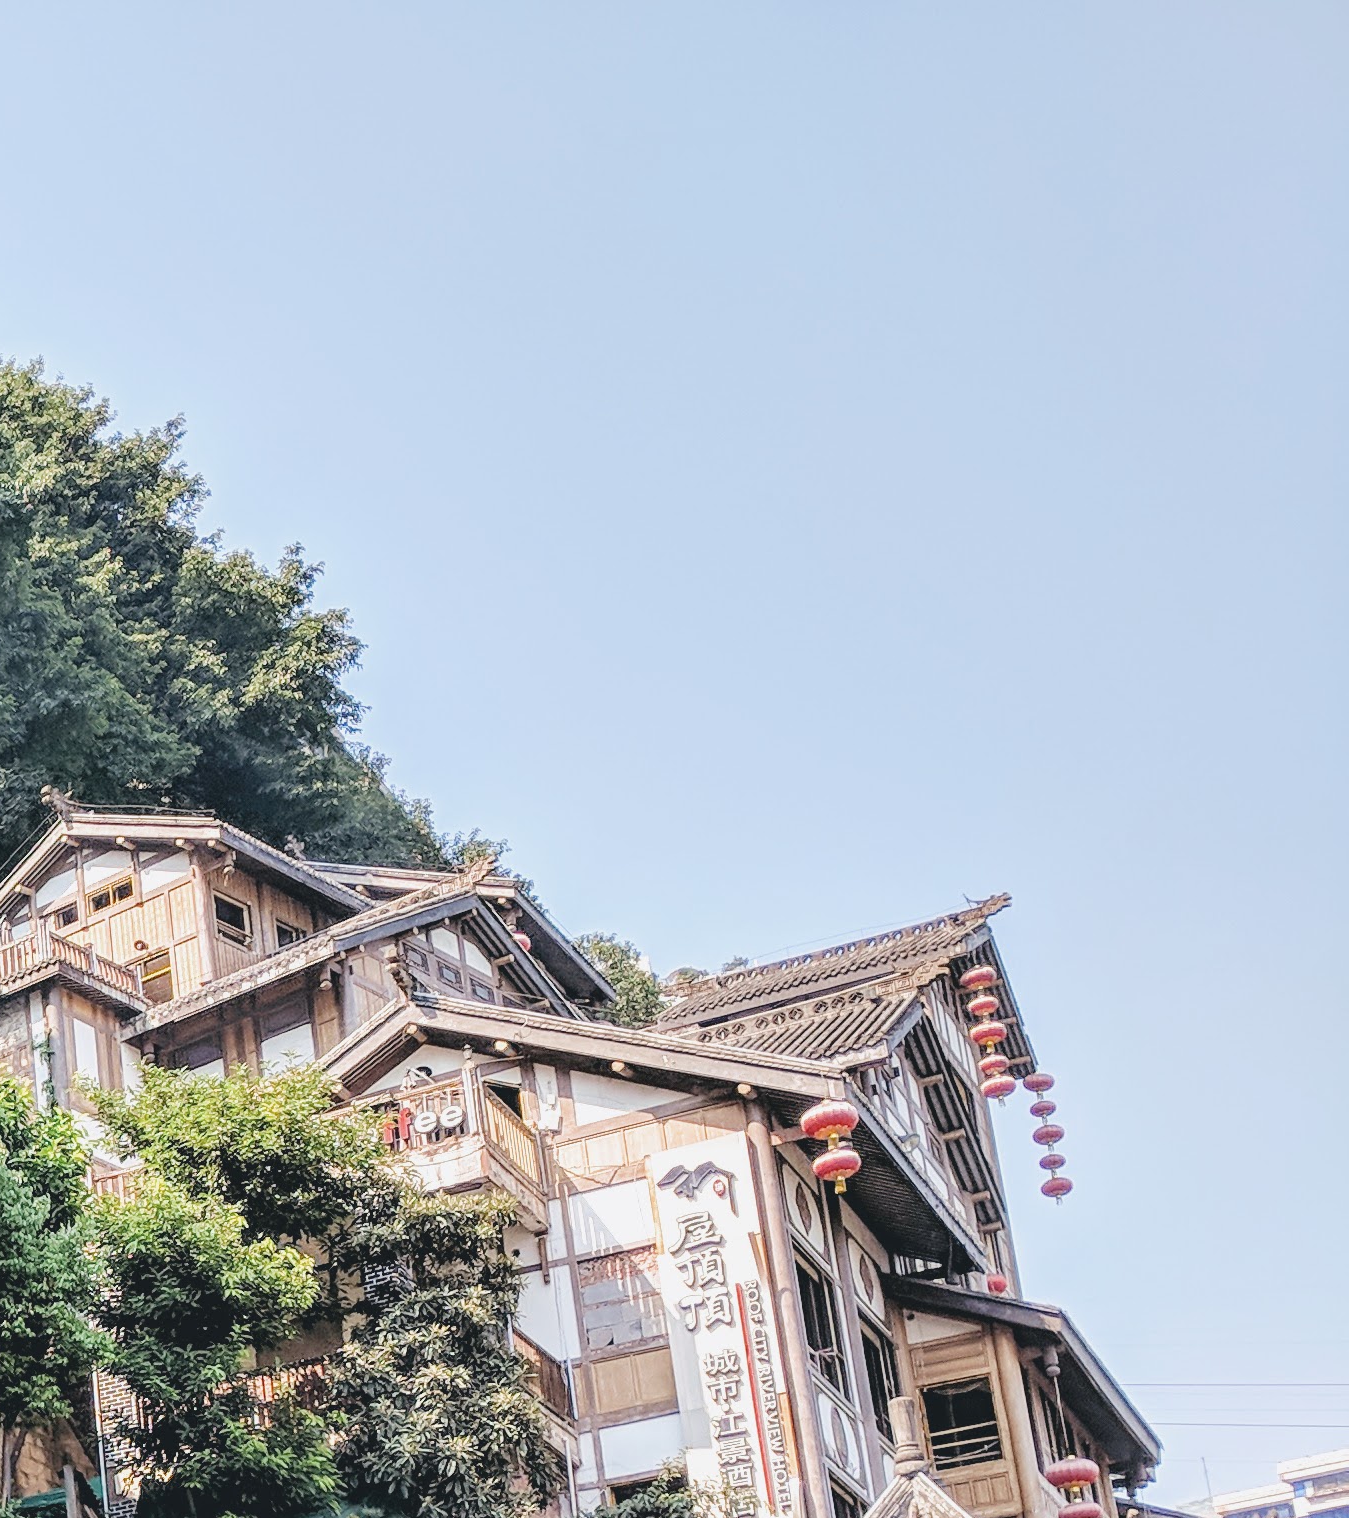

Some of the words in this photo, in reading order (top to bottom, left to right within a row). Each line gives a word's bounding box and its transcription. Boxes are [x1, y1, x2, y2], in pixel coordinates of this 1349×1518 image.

[744, 1279, 764, 1324] ROOF
[752, 1327, 771, 1365] CITY
[772, 1456, 793, 1514] HOTEL
